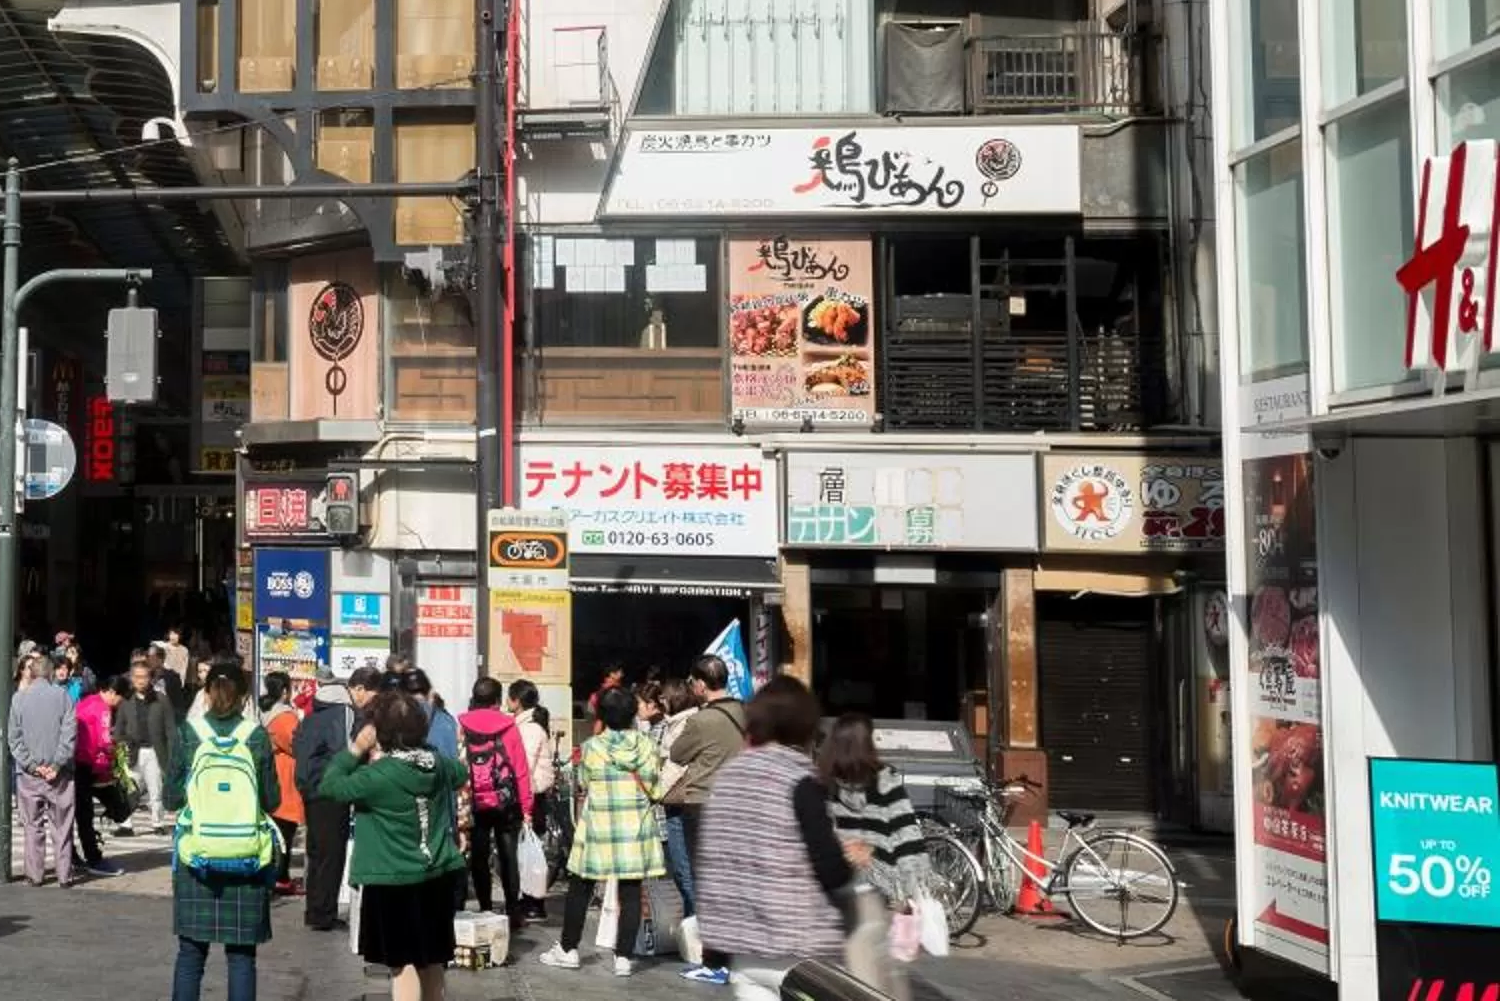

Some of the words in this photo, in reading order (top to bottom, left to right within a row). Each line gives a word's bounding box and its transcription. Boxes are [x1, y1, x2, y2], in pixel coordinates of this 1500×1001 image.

[1396, 141, 1500, 371] H&
[525, 460, 764, 501] テナント募集中
[790, 508, 876, 544] テナン
[607, 530, 715, 546] 0120-63-0605
[267, 576, 293, 590] BOSS
[1380, 791, 1493, 814] KNITWEAR
[1420, 840, 1437, 850] UP
[1441, 841, 1456, 851] TO
[1389, 853, 1491, 898] 50%
[1458, 883, 1491, 898] OFF
